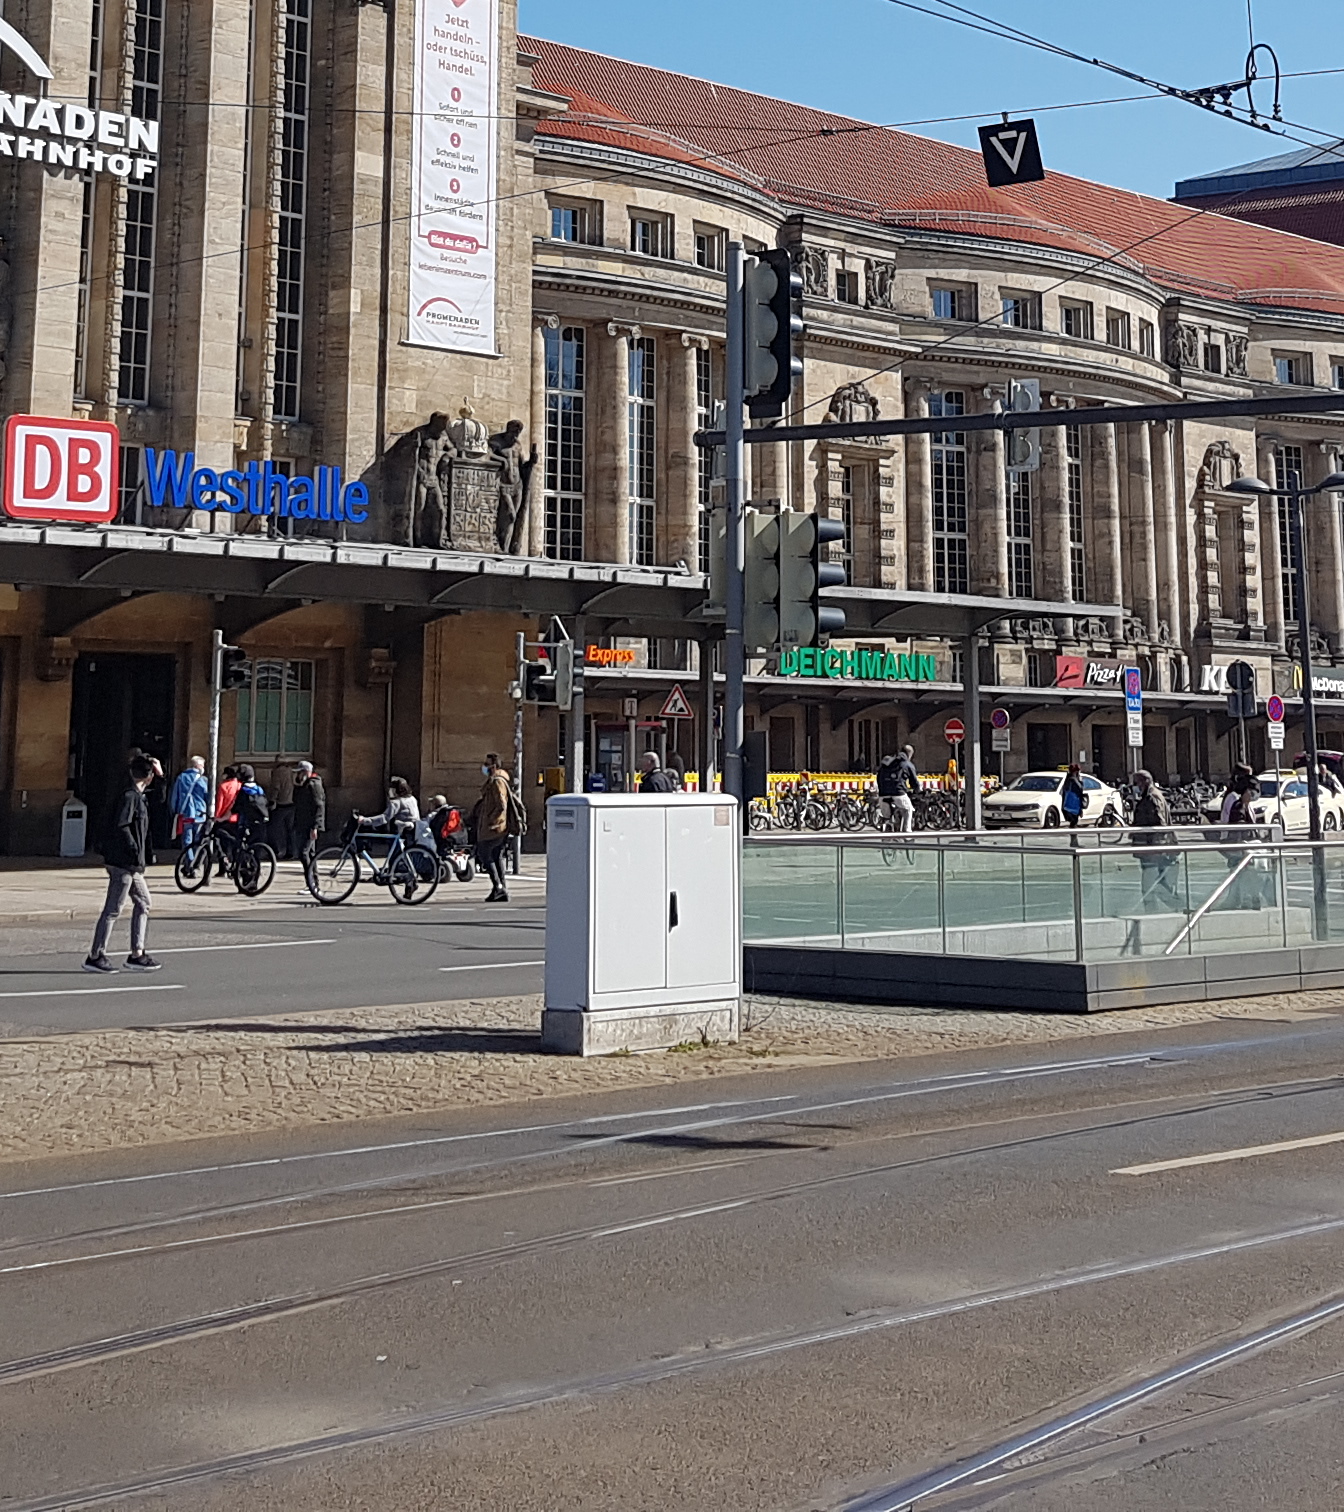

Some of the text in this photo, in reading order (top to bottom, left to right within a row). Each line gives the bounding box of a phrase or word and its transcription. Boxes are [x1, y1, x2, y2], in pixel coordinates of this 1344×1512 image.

[445, 13, 469, 29] Jetzt
[433, 25, 473, 46] handeln
[426, 41, 447, 54] oder
[426, 311, 480, 325] PROMENADEN
[22, 433, 104, 503] DB
[144, 447, 370, 524] Westhalle
[586, 644, 635, 666] Express
[780, 647, 936, 681] DEICHMANN
[1086, 662, 1116, 684] Pizza
